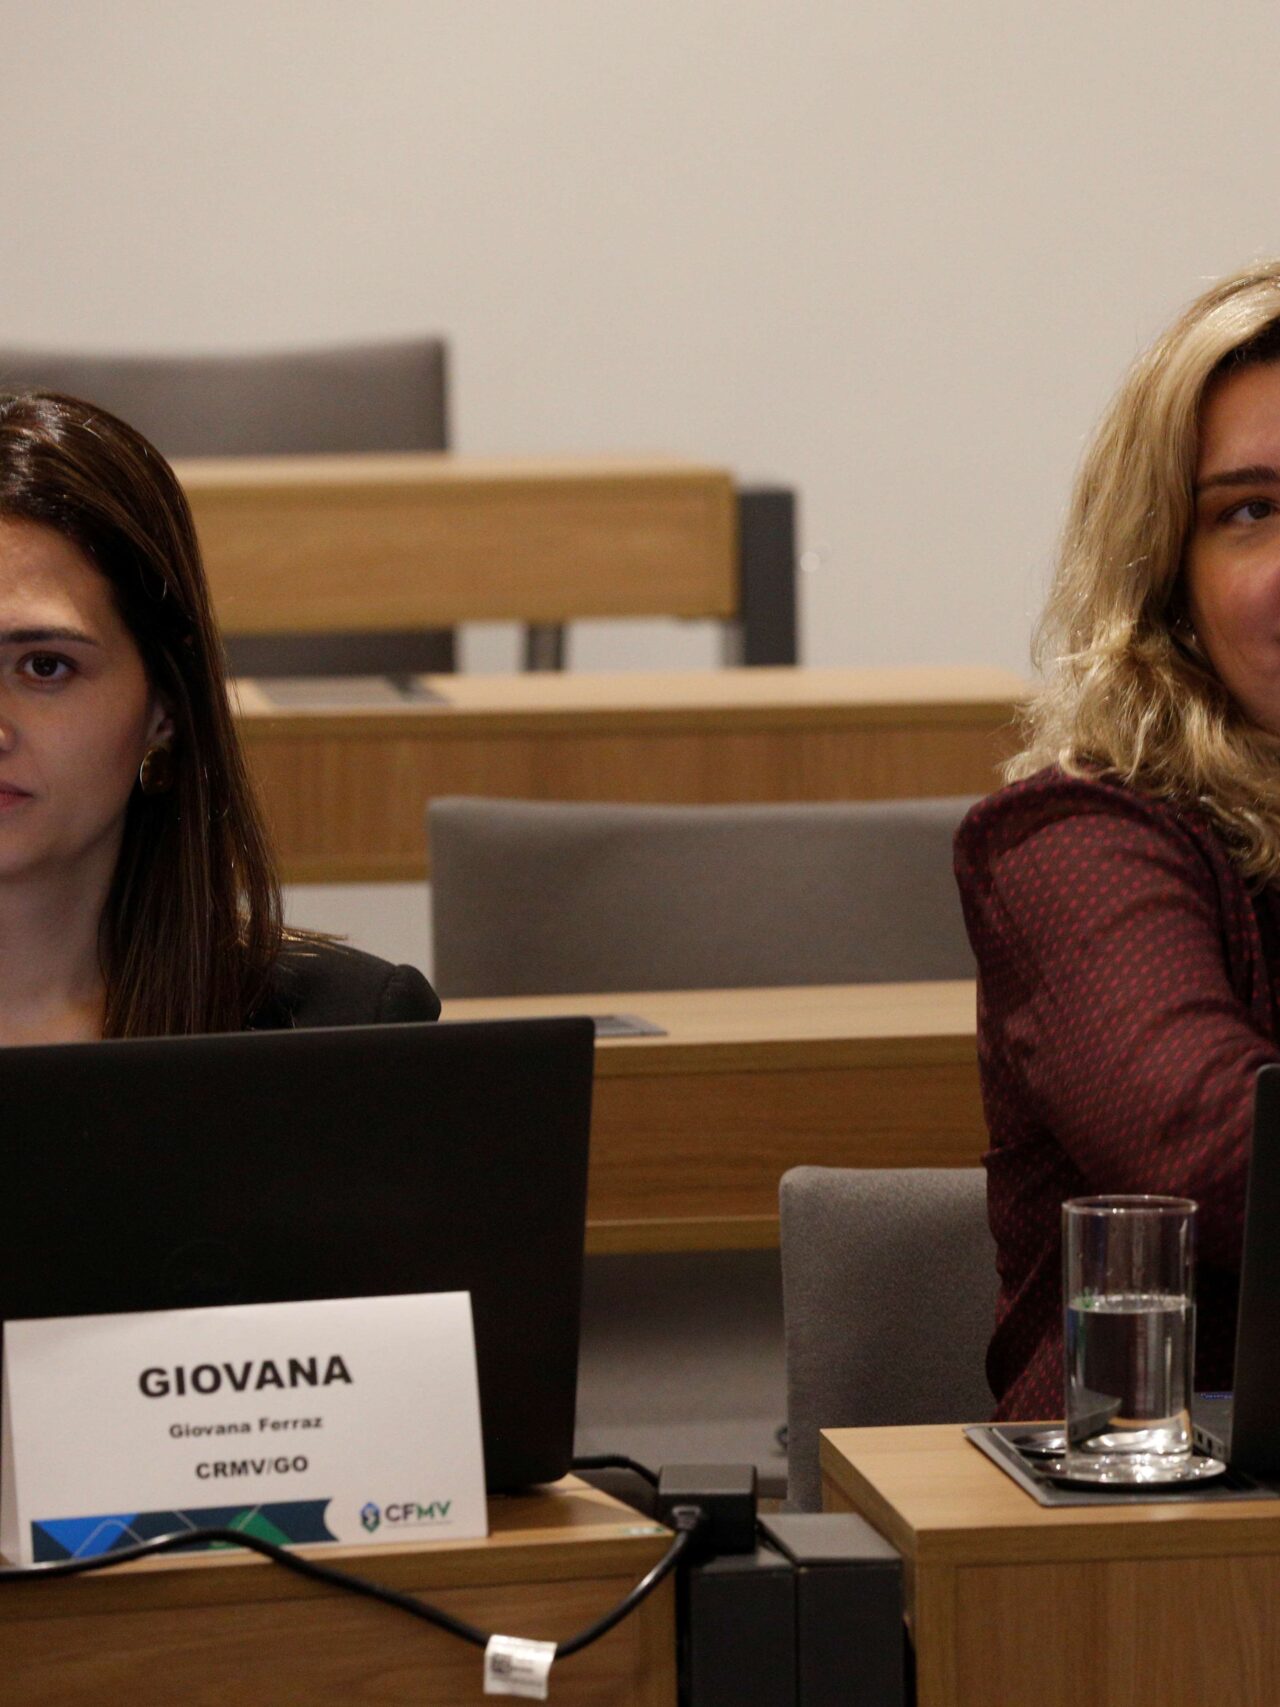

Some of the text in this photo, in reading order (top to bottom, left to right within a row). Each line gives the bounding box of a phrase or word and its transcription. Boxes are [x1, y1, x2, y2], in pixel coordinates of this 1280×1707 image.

[139, 1355, 353, 1399] GIOVANA
[169, 1417, 322, 1438] Giovana Ferraz
[196, 1456, 309, 1479] CRMV/GO
[385, 1500, 452, 1522] CFMV
